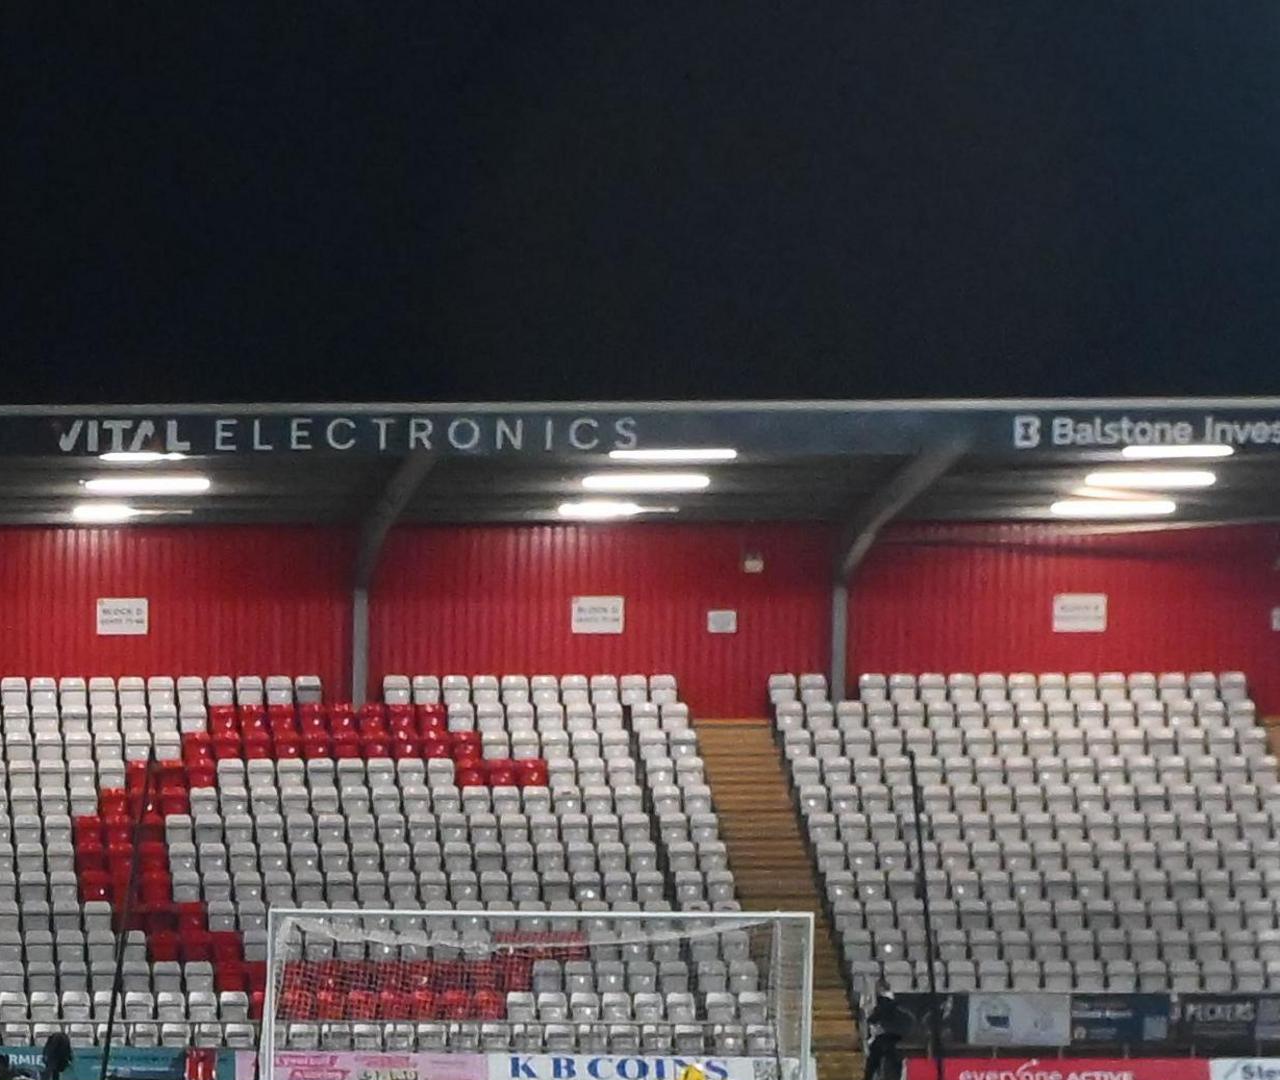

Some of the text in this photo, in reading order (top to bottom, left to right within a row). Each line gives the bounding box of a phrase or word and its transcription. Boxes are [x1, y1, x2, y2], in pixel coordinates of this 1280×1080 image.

[215, 417, 639, 451] ELECTRONICS
[1052, 417, 1192, 445] Balstone
[509, 1057, 537, 1078] K
[552, 1058, 576, 1079] B
